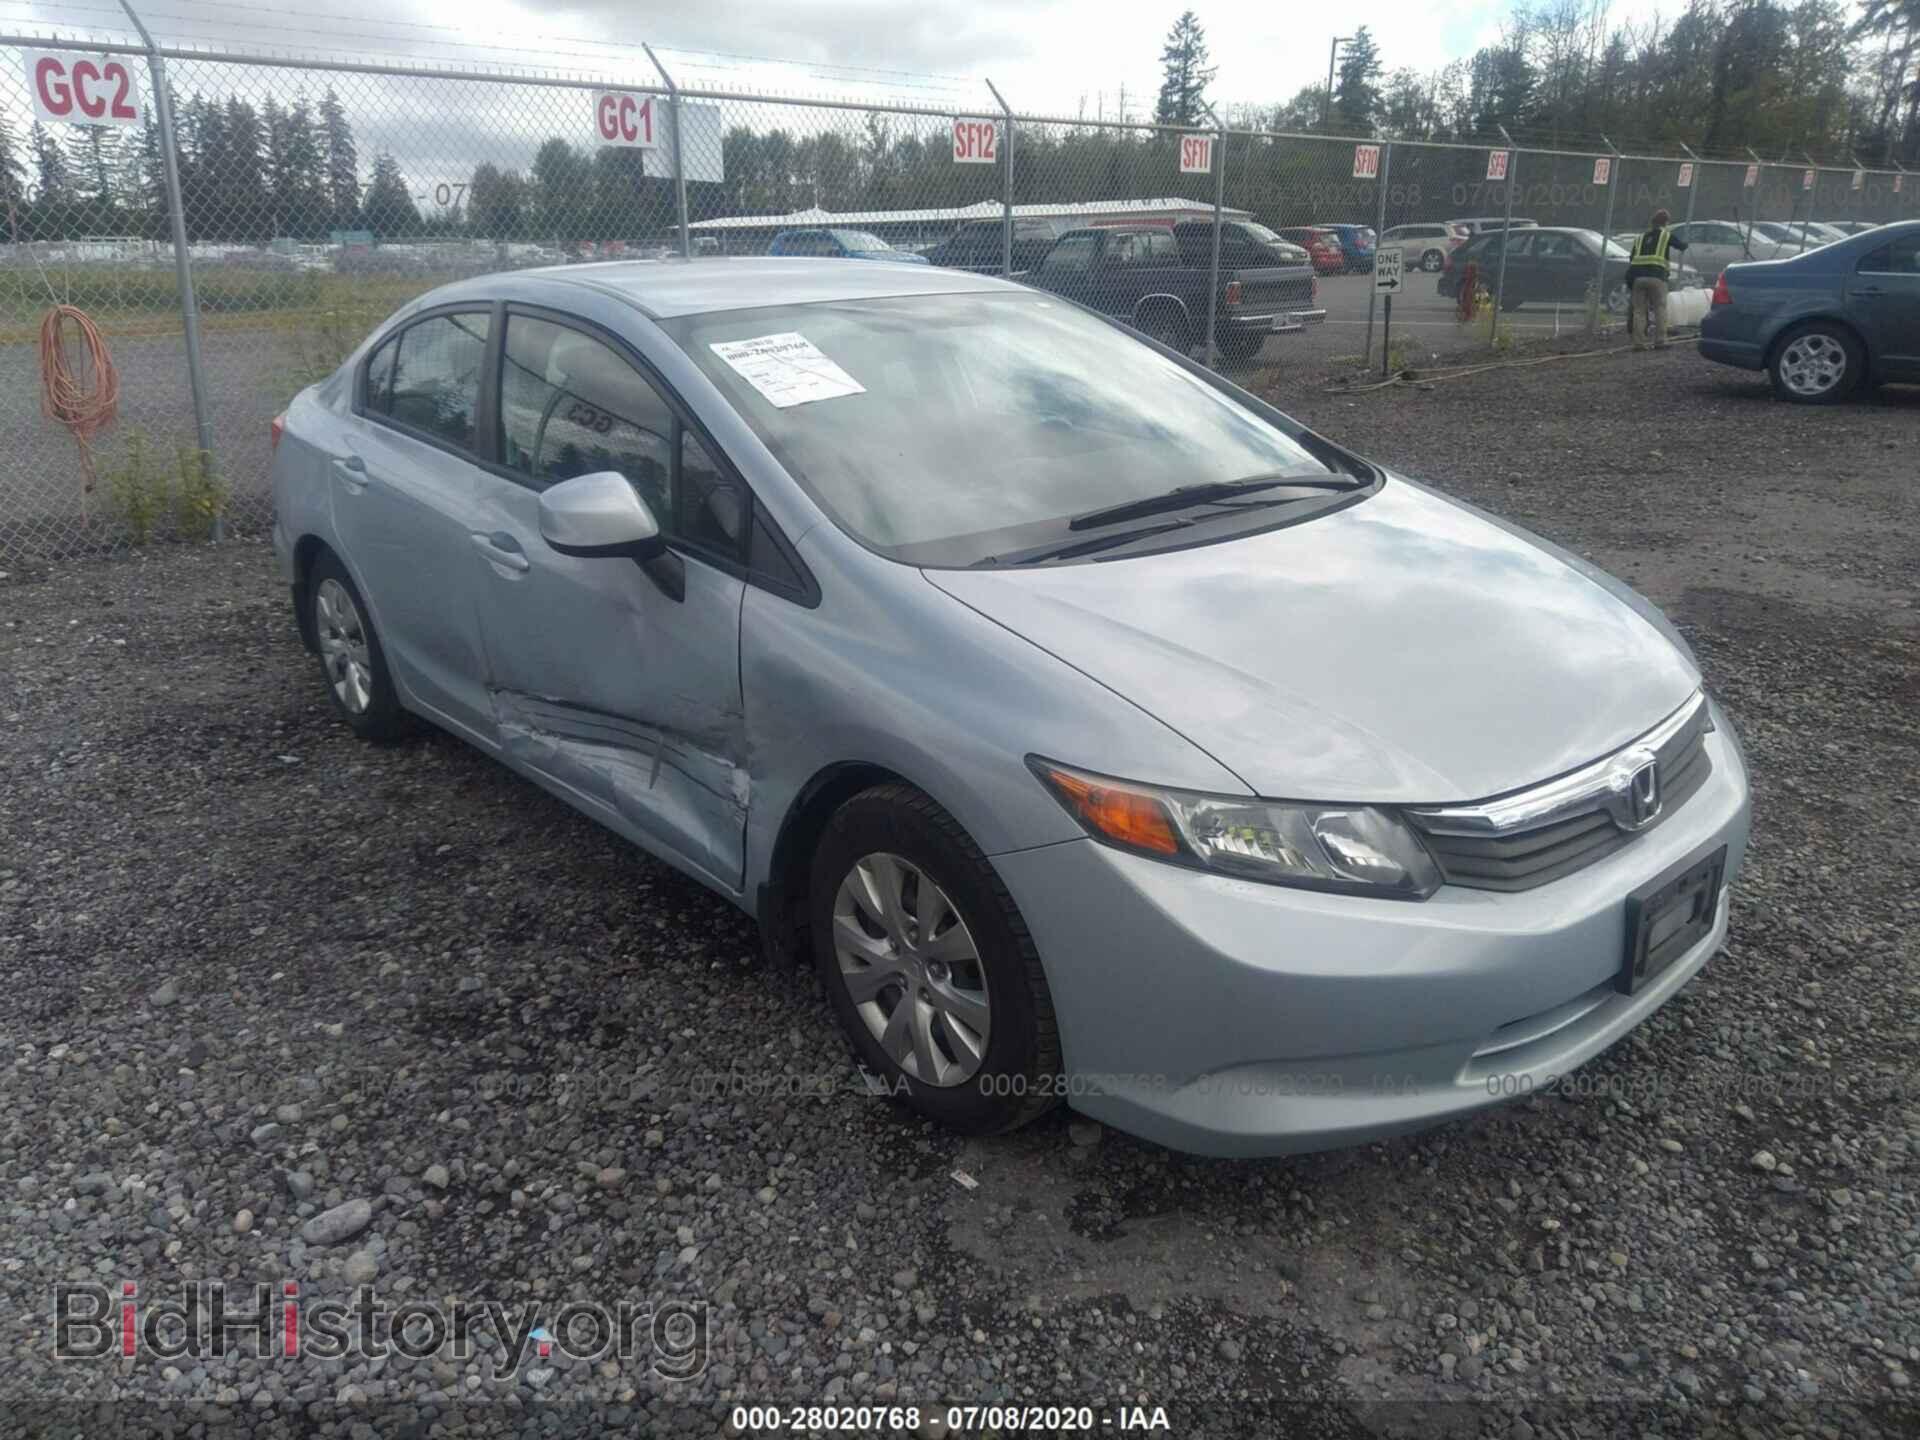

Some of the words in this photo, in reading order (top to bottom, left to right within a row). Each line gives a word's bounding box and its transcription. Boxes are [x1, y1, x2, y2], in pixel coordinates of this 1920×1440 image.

[36, 57, 136, 119] GC2
[598, 95, 651, 143] GC1
[955, 122, 994, 158] SF12
[1184, 138, 1208, 168] SF11
[1356, 149, 1377, 174] SF10
[1377, 252, 1401, 265] ONE
[1377, 264, 1401, 278] WAY
